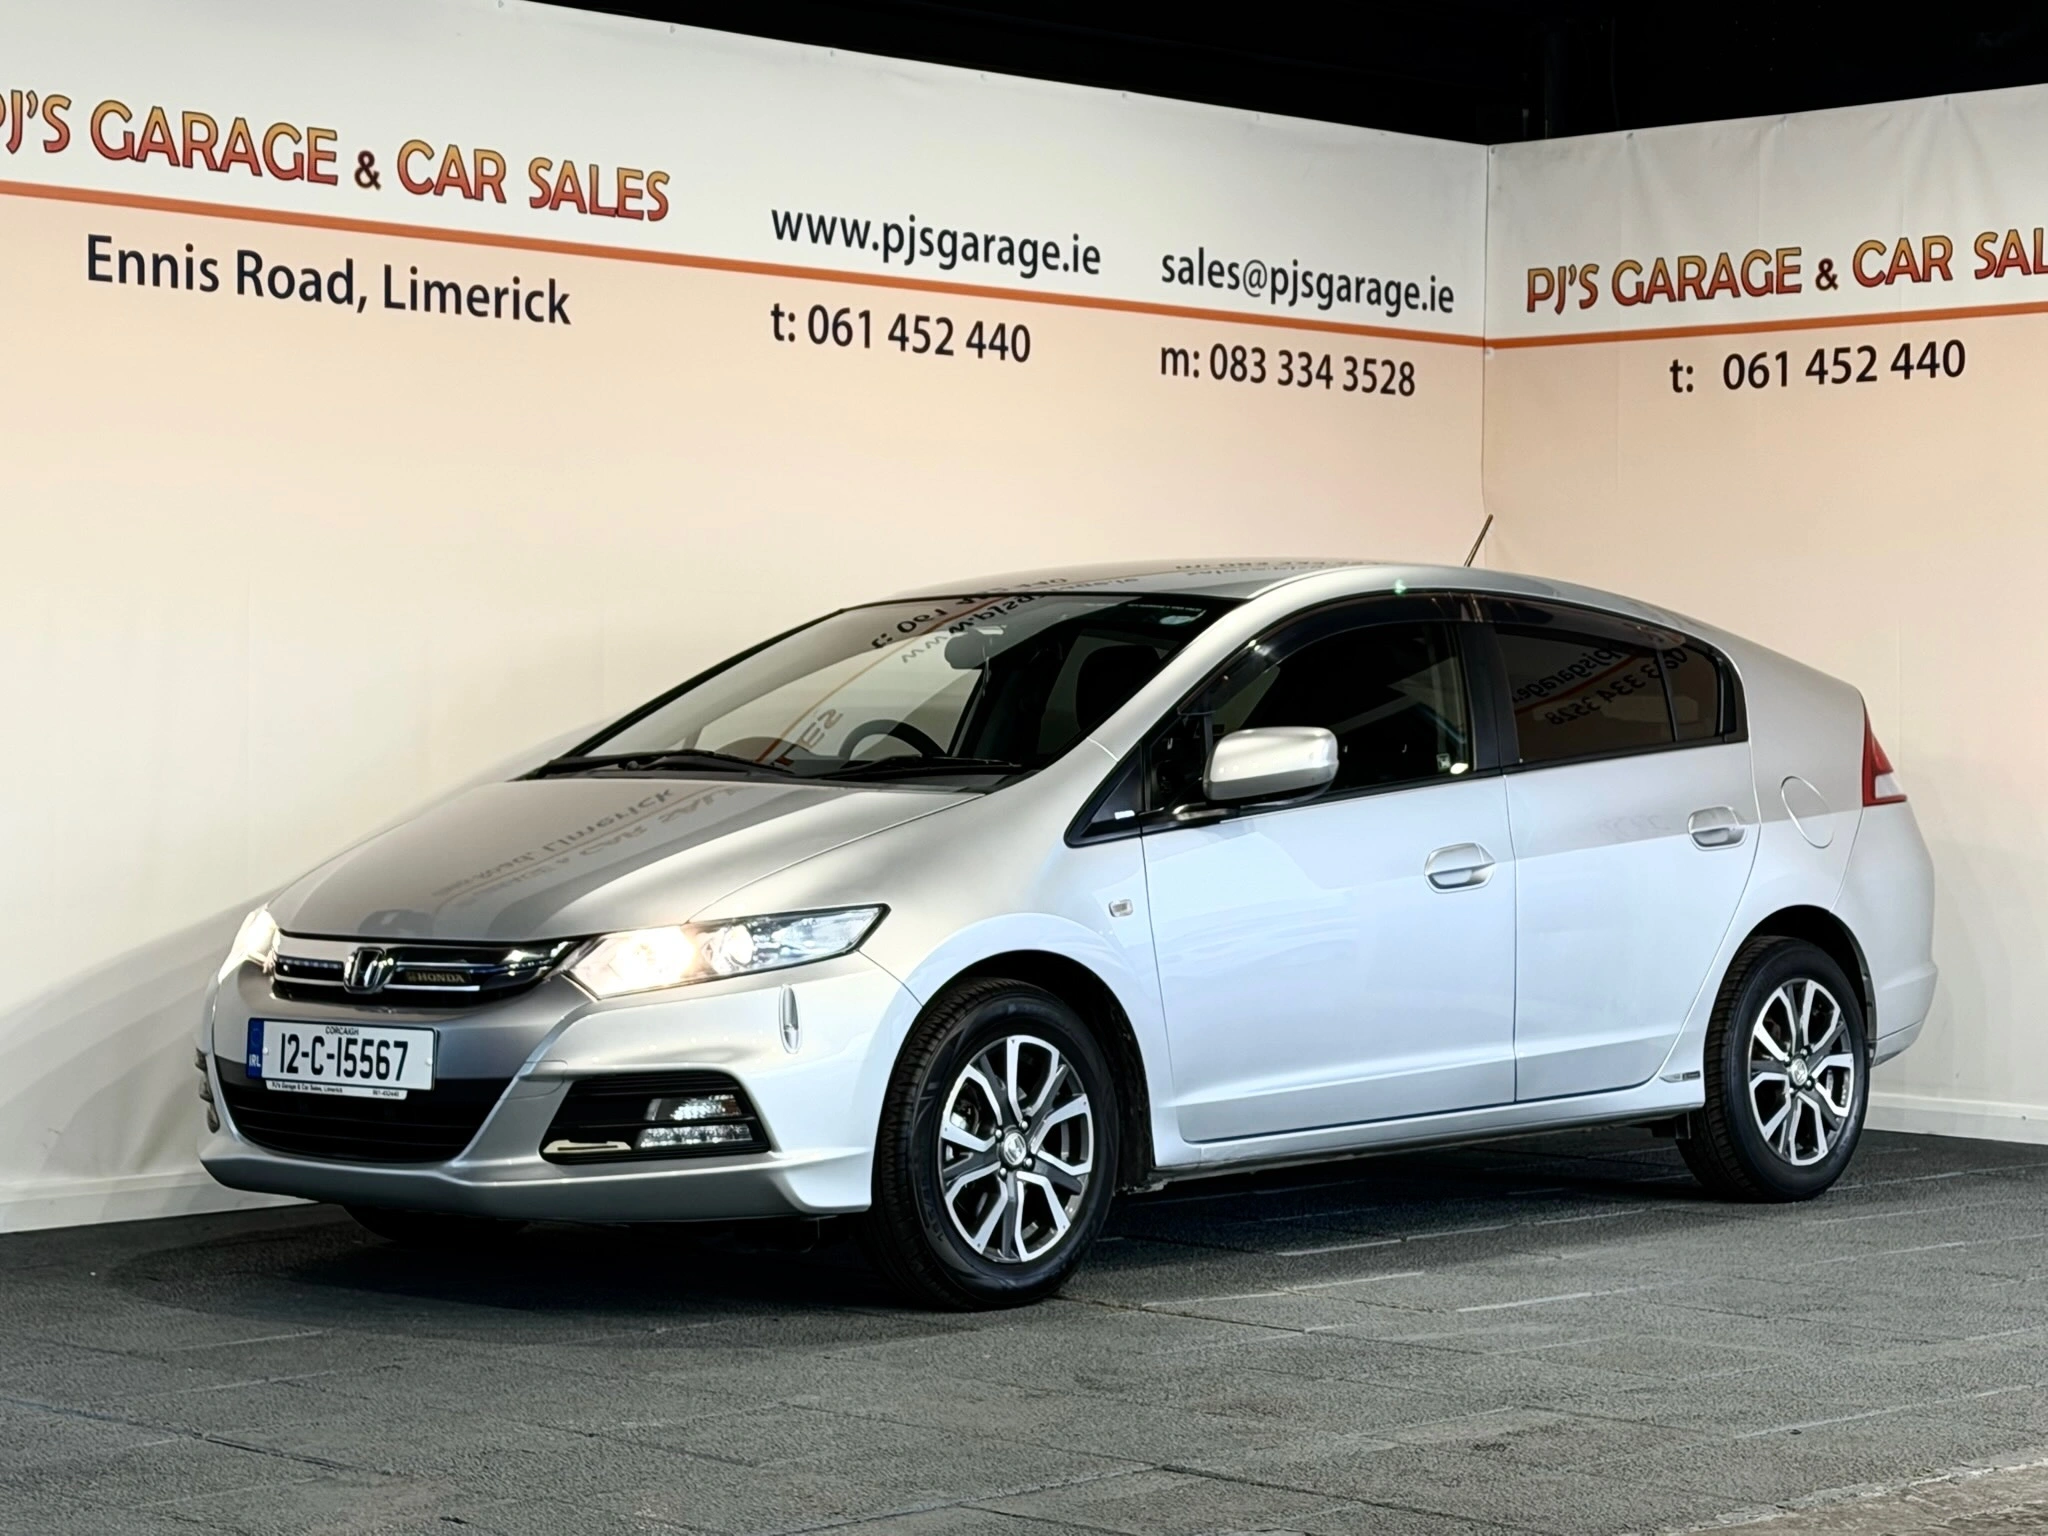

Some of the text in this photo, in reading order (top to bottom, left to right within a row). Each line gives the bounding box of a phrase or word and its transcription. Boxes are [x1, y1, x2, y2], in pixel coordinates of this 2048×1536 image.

[90, 99, 338, 186] GARAGE
[354, 150, 381, 191] &
[397, 139, 507, 204] CAR
[528, 157, 670, 222] SALES
[771, 209, 1101, 278] www.pjsgarage.ie
[88, 234, 571, 325] Ennis Road, Limerick
[1161, 247, 1455, 317] sales@pjsgarage.ie
[1527, 263, 1600, 315] PJ'S
[1611, 247, 1802, 307] GARAGE
[1815, 258, 1839, 291] &
[1852, 235, 1953, 288] CAR
[771, 303, 1031, 363] t: 061 452 440
[1160, 343, 1416, 397] m: 083 334 3528
[1670, 339, 1966, 393] t: 061 452 440
[416, 972, 466, 984] HONDA
[280, 1033, 409, 1082] 12-C-15567
[325, 1025, 359, 1036] CORCAIGH
[249, 1053, 261, 1068] IRL
